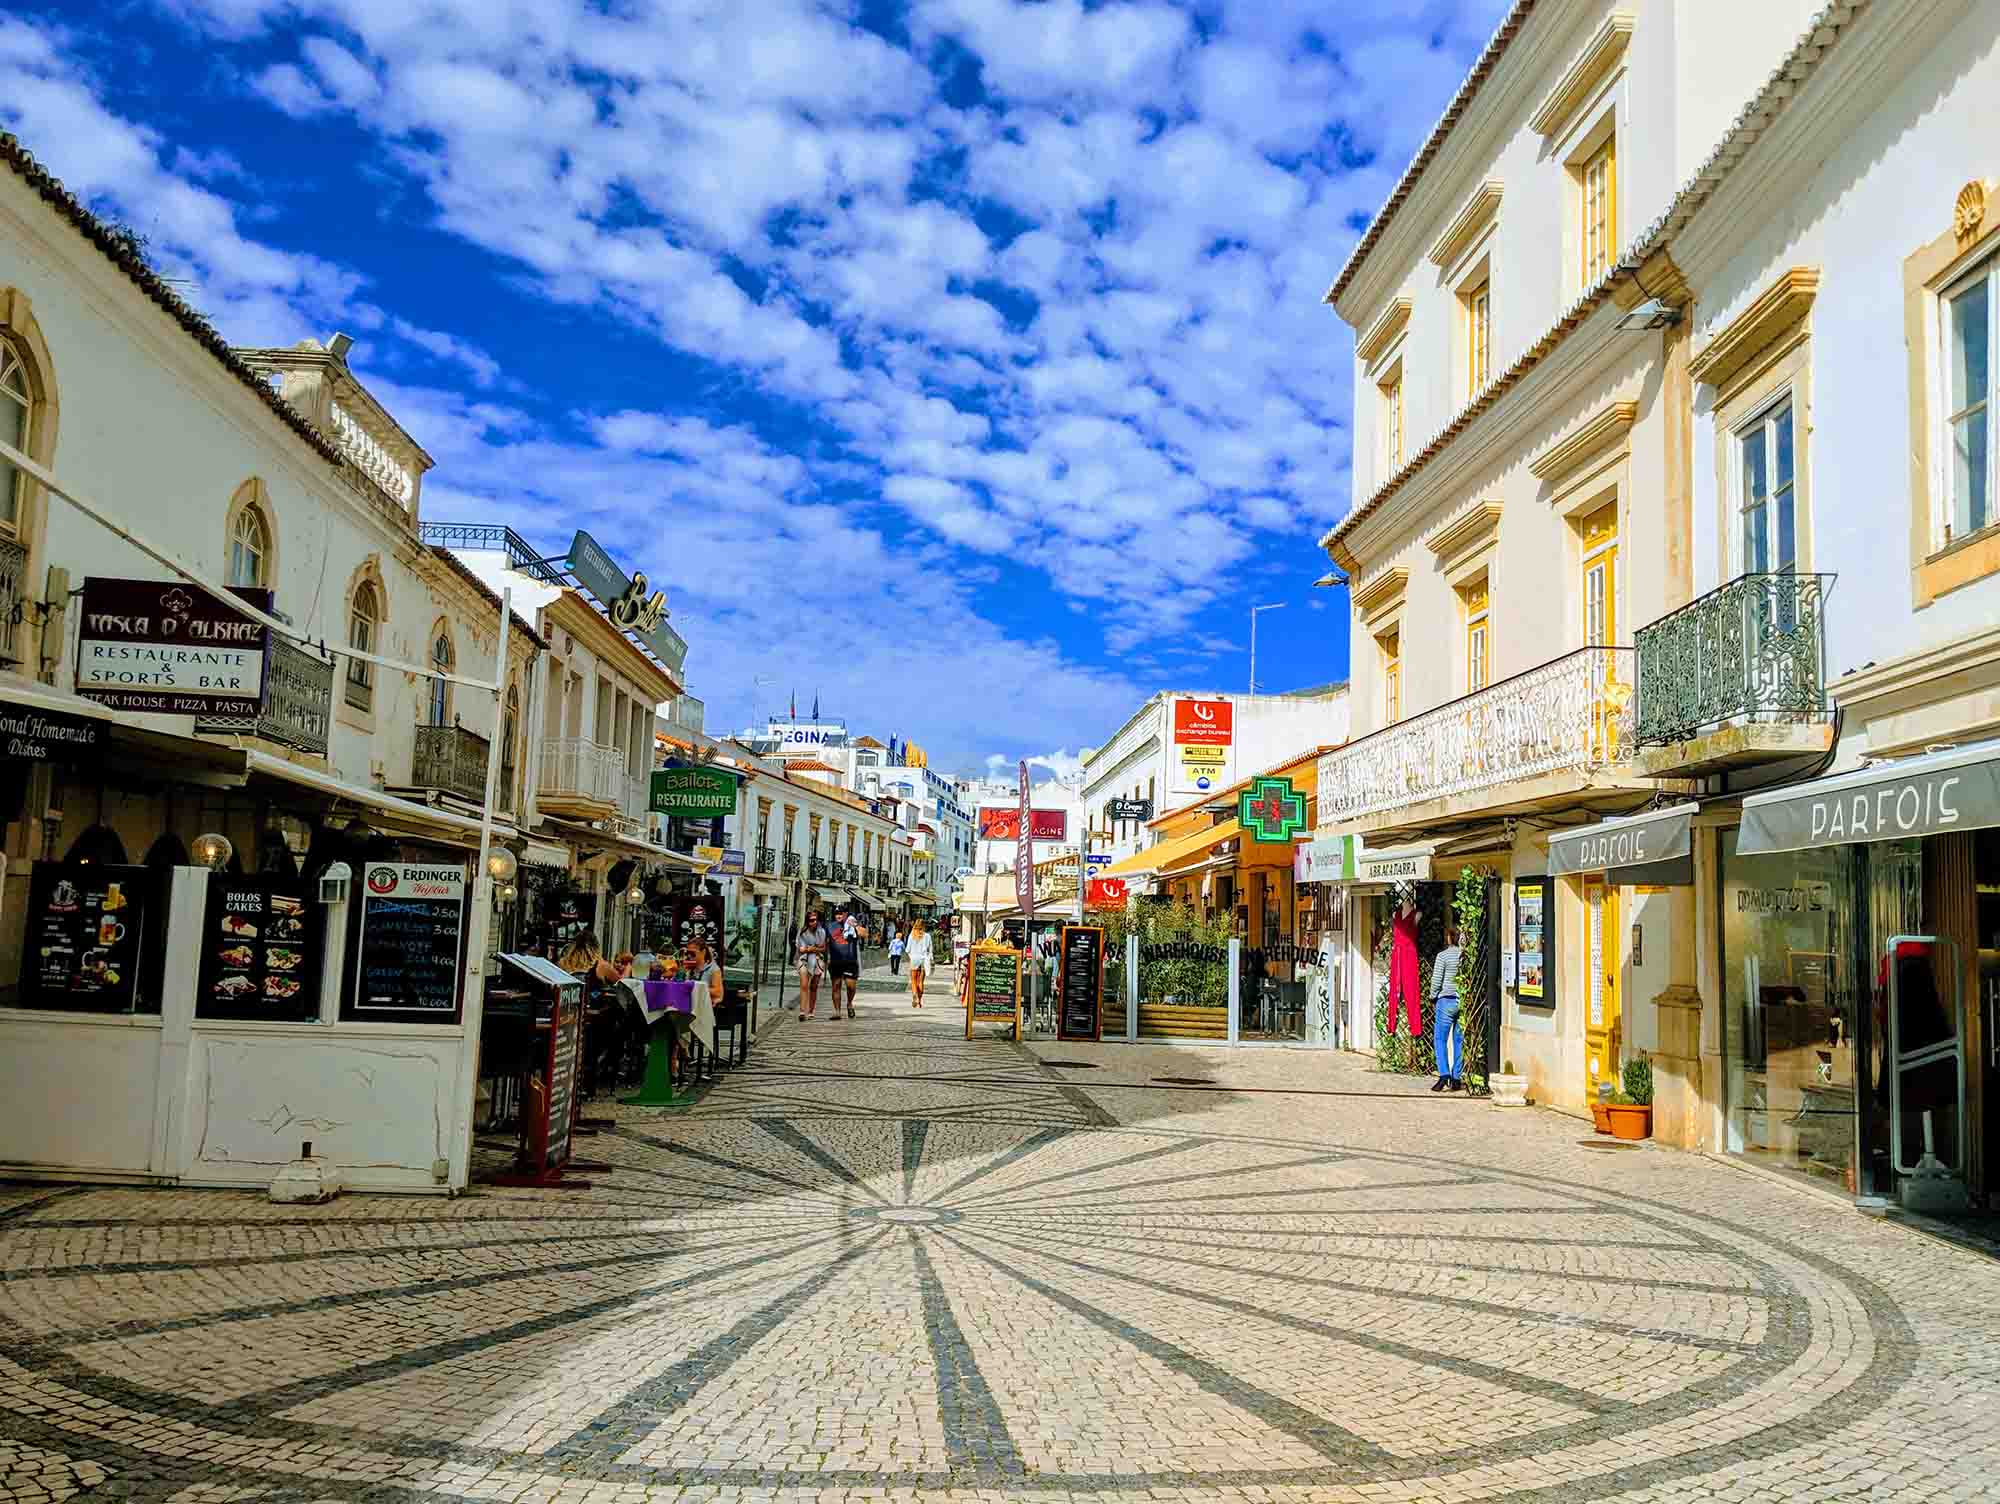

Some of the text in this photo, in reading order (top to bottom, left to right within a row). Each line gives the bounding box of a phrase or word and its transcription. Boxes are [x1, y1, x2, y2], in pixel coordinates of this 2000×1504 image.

[88, 614, 149, 636] TASCA
[94, 646, 244, 666] RESTAURANTE
[161, 662, 172, 673] &
[91, 669, 241, 689] SPORTS BAR
[123, 694, 166, 709] HOUSE
[174, 697, 207, 711] PIZZA
[215, 702, 254, 714] PASTA
[0, 712, 96, 744] onal Homemade
[8, 738, 47, 758] Dishes
[1192, 767, 1216, 775] ATM
[656, 793, 731, 808] RESTAURANTE
[1811, 777, 1960, 841] PARFOIS
[1032, 827, 1063, 836] AGINE
[1580, 829, 1646, 866] PARFOIS
[403, 869, 462, 883] ERDINGER
[226, 892, 260, 902] BOLOS
[225, 902, 262, 912] CAKES
[1175, 930, 1191, 941] THE
[1139, 942, 1227, 961] WAREHOUSE
[1258, 945, 1328, 968] REHOUSE
